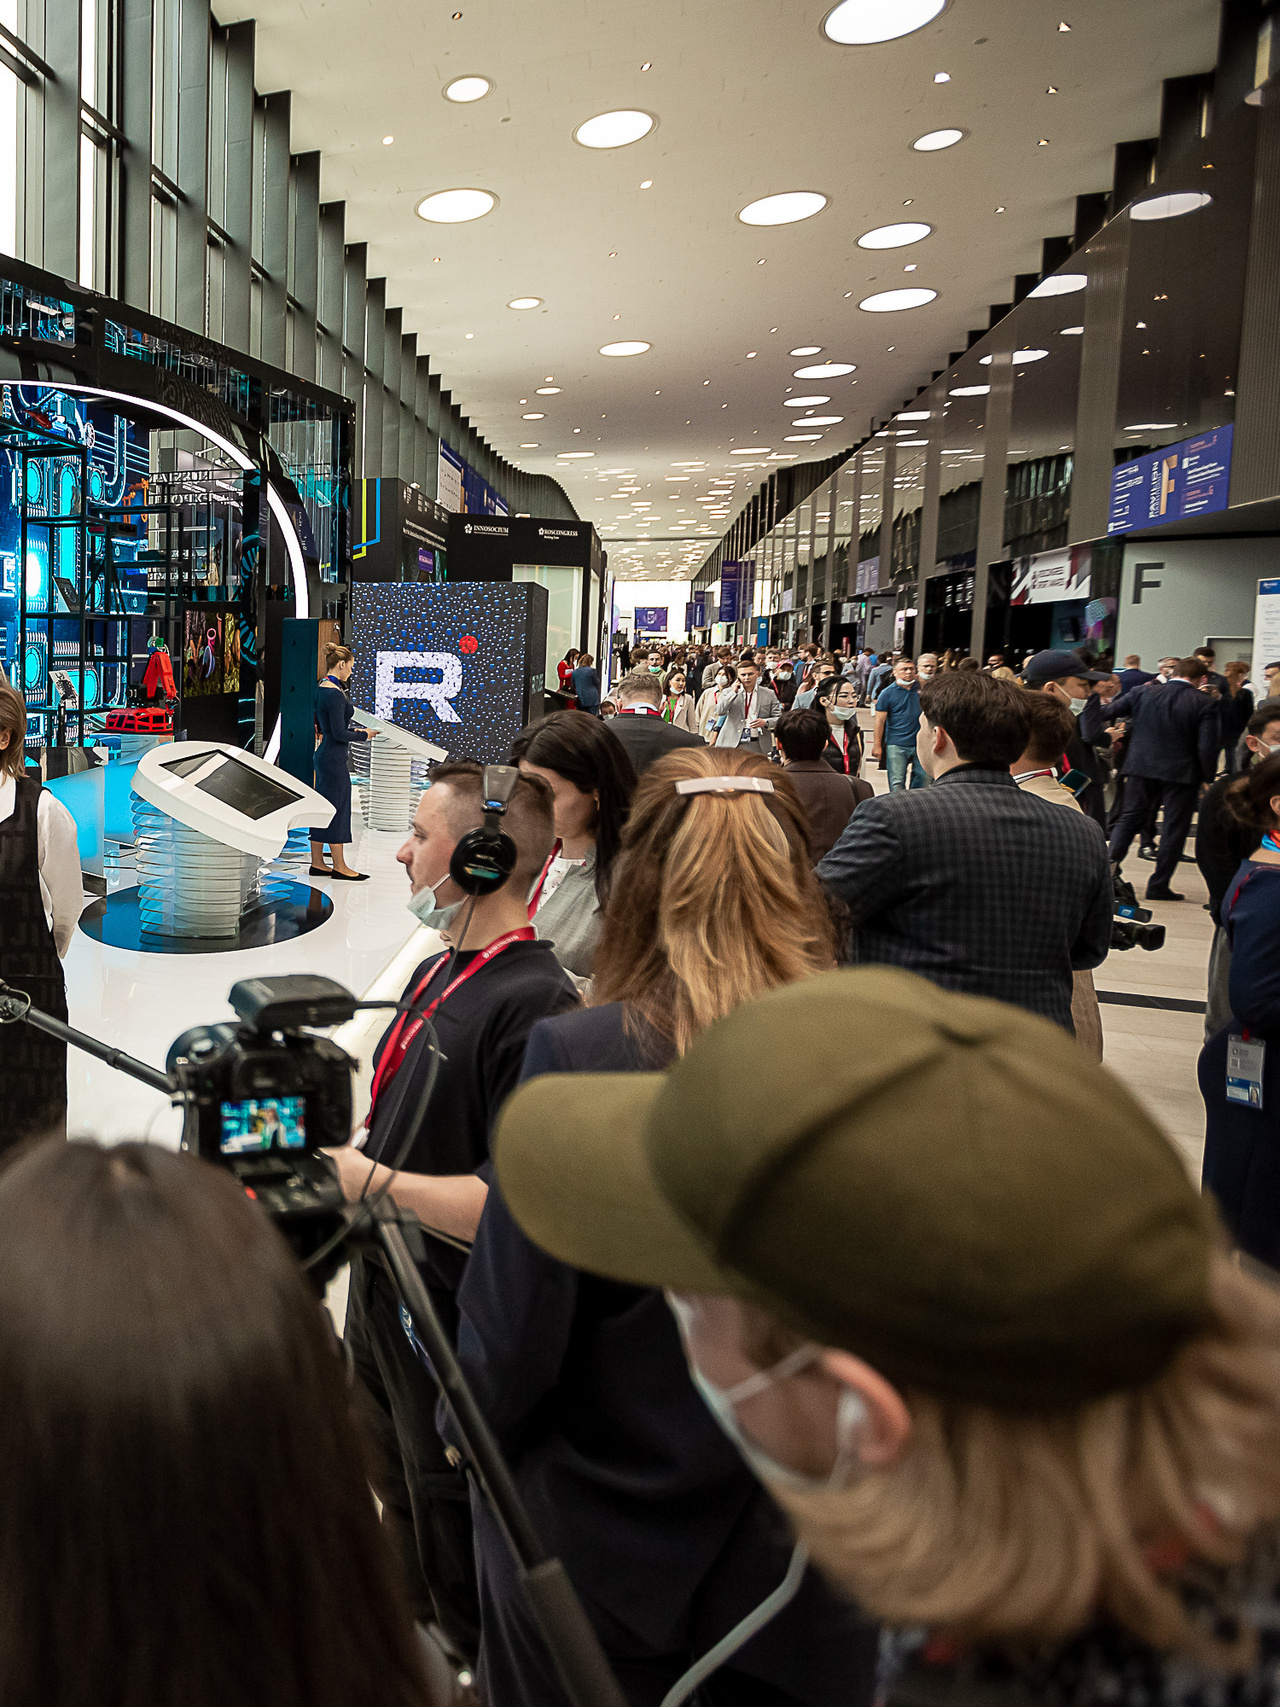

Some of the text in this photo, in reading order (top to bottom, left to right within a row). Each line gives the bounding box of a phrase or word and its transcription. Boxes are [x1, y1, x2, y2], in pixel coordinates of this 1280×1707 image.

[474, 525, 509, 533] INNOSOCIUM
[1131, 562, 1165, 604] F
[870, 606, 883, 625] F
[375, 651, 463, 723] R
